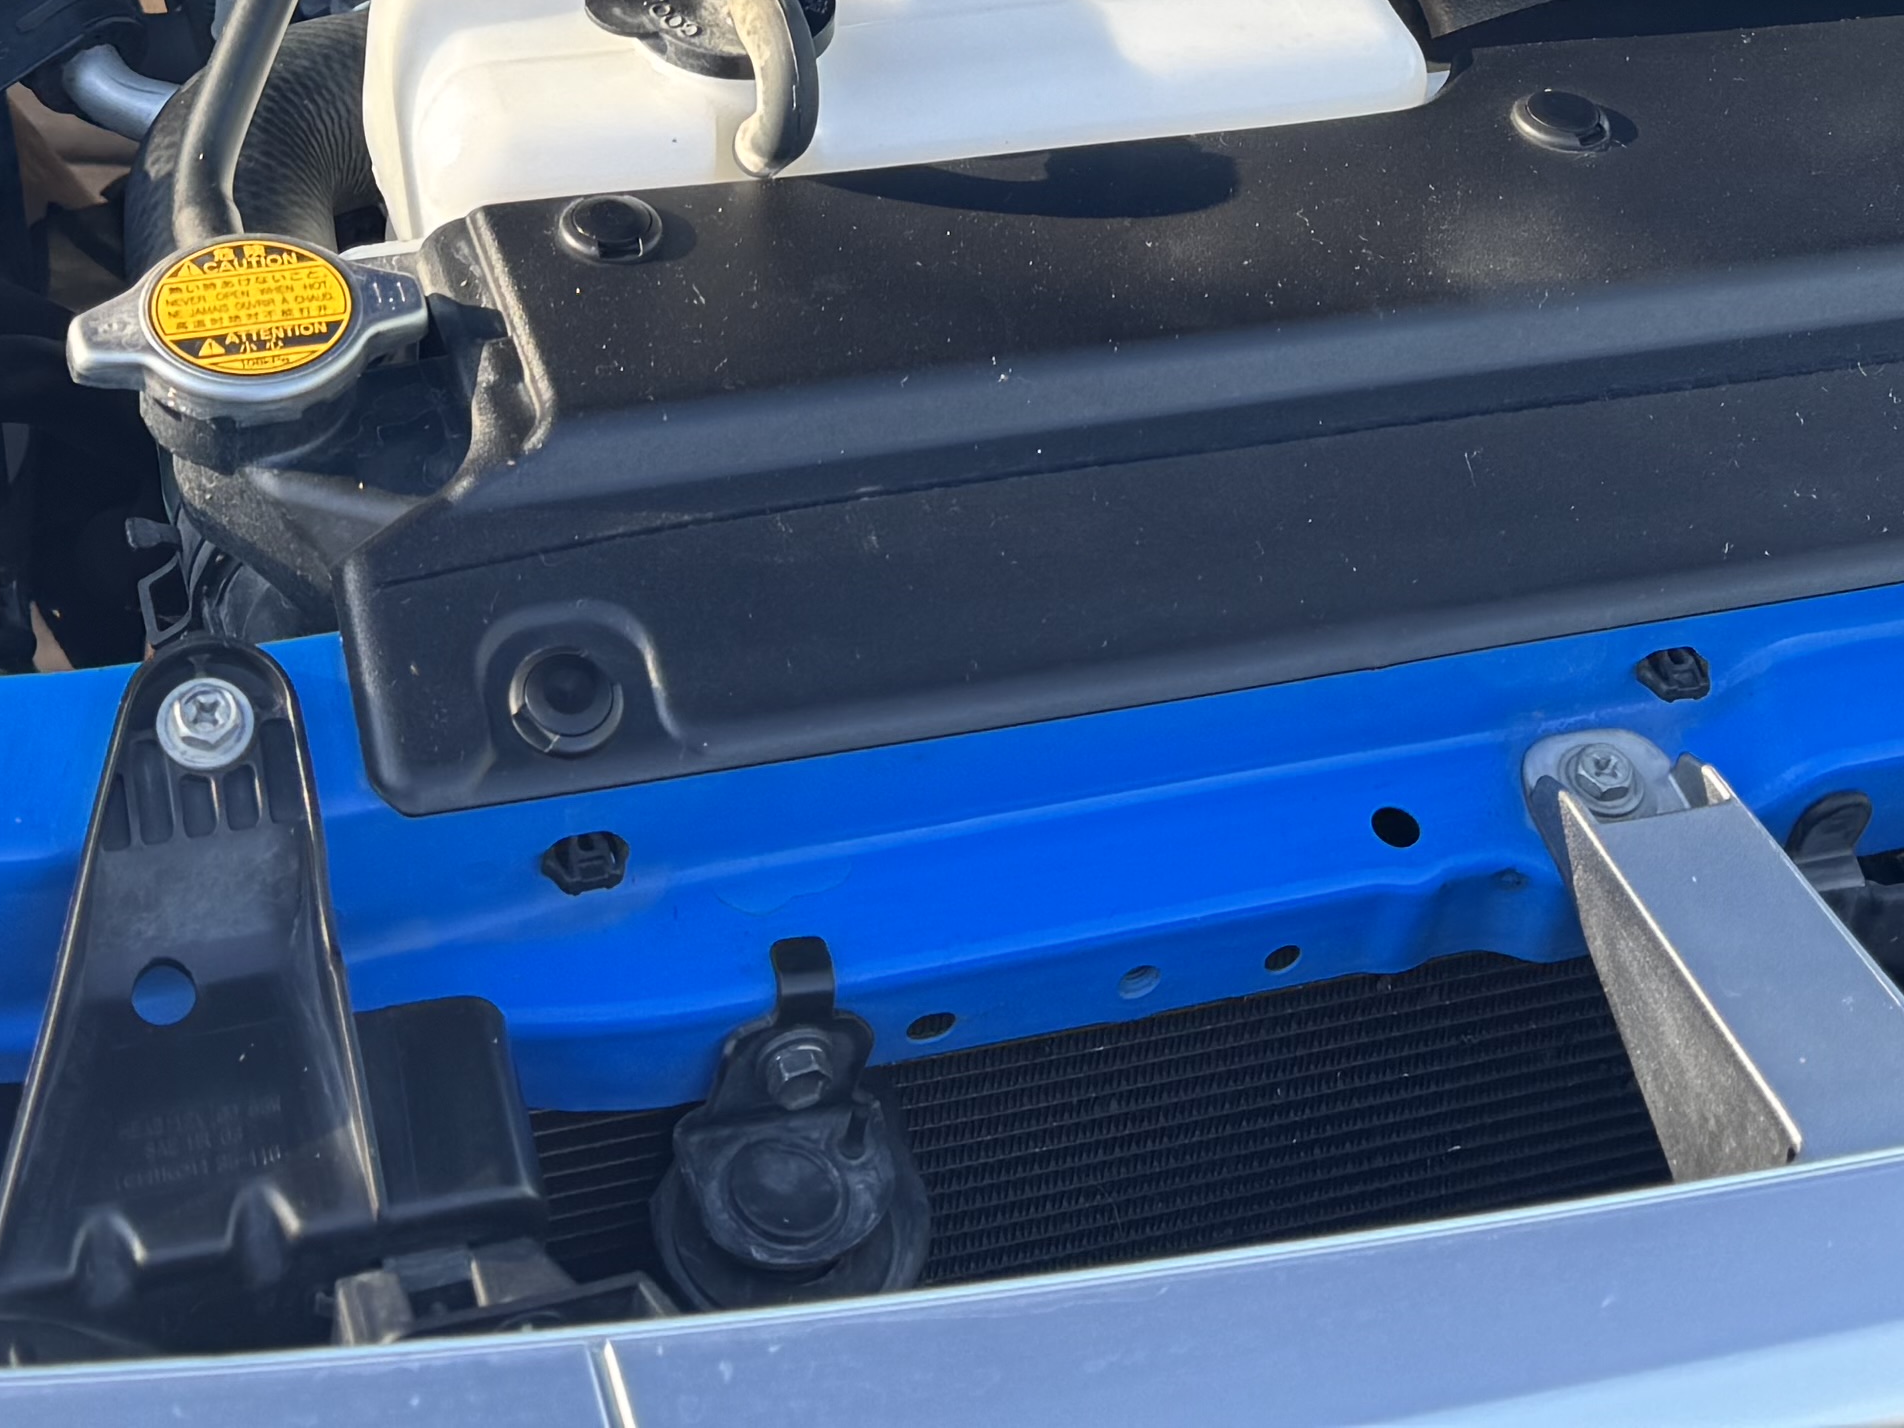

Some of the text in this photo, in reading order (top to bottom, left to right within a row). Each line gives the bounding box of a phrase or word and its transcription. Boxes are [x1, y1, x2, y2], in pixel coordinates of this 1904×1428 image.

[202, 252, 298, 274] CAUTION
[166, 293, 209, 307] NEVER
[215, 288, 250, 302] OPEN
[259, 284, 295, 298] WHEN
[167, 308, 182, 319] NE
[189, 303, 230, 318] JAMAIS
[235, 298, 278, 311] OUVRIR
[225, 321, 328, 343] ATTENTION
